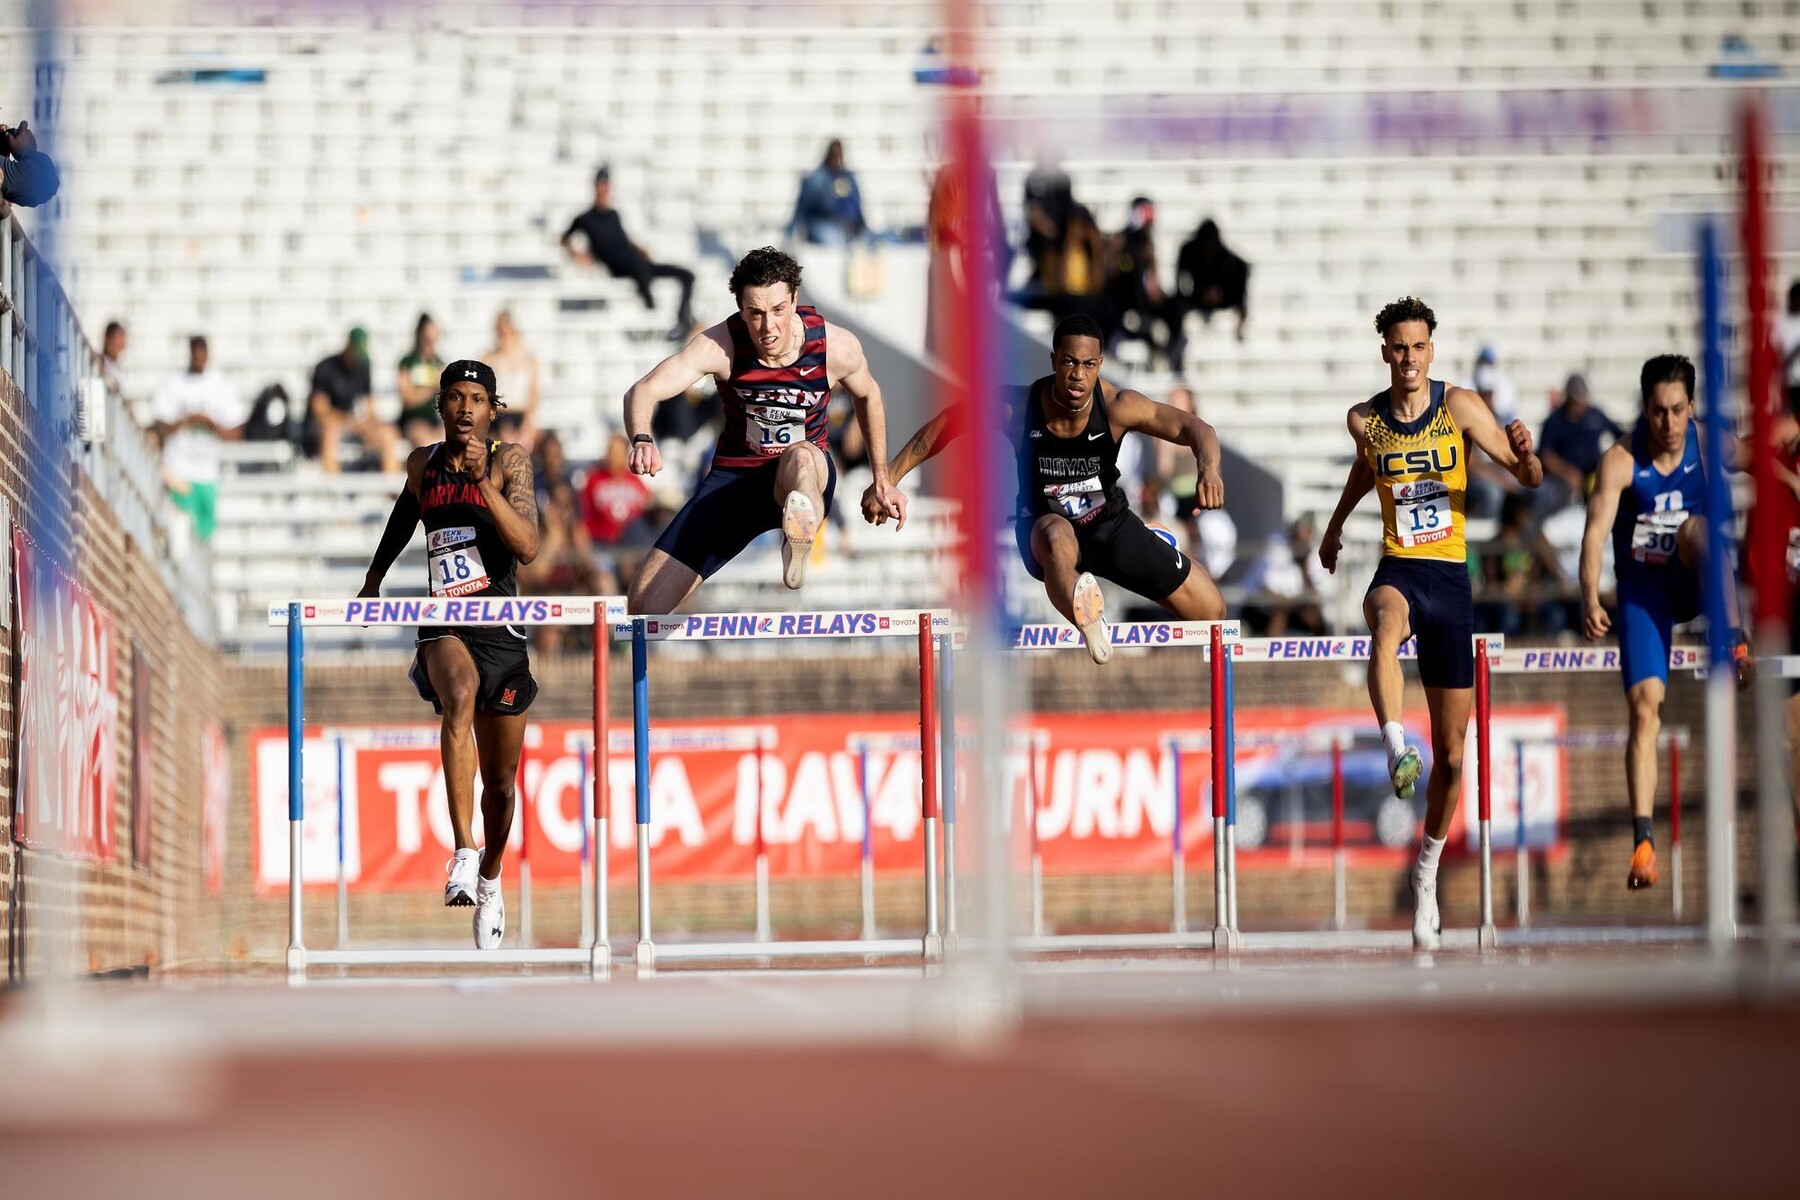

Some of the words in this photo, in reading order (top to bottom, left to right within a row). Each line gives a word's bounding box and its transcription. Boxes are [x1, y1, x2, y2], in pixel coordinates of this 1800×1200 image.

[735, 388, 825, 407] PENN
[760, 427, 791, 445] 16
[1038, 456, 1101, 477] HOYAS
[1415, 481, 1434, 489] PENN
[1415, 486, 1441, 496] RELAYS
[1062, 493, 1092, 517] 14
[1409, 504, 1440, 531] 13
[1415, 533, 1448, 544] TOYOTA
[1646, 532, 1675, 552] 30
[439, 554, 471, 585] 18
[447, 581, 484, 598] TOYOTA
[345, 601, 421, 622] PENN
[444, 601, 548, 622] RELAYS
[660, 623, 685, 631] TOYOTA
[685, 616, 757, 637] PENN
[778, 613, 877, 635] RELAYS
[1184, 629, 1209, 637] TOYOTA
[1006, 627, 1058, 647] ENN
[1078, 624, 1170, 645] LAYS
[1268, 641, 1331, 658] PENN
[1351, 637, 1418, 657] RAY
[1524, 652, 1584, 668] PENN
[500, 688, 517, 706] M
